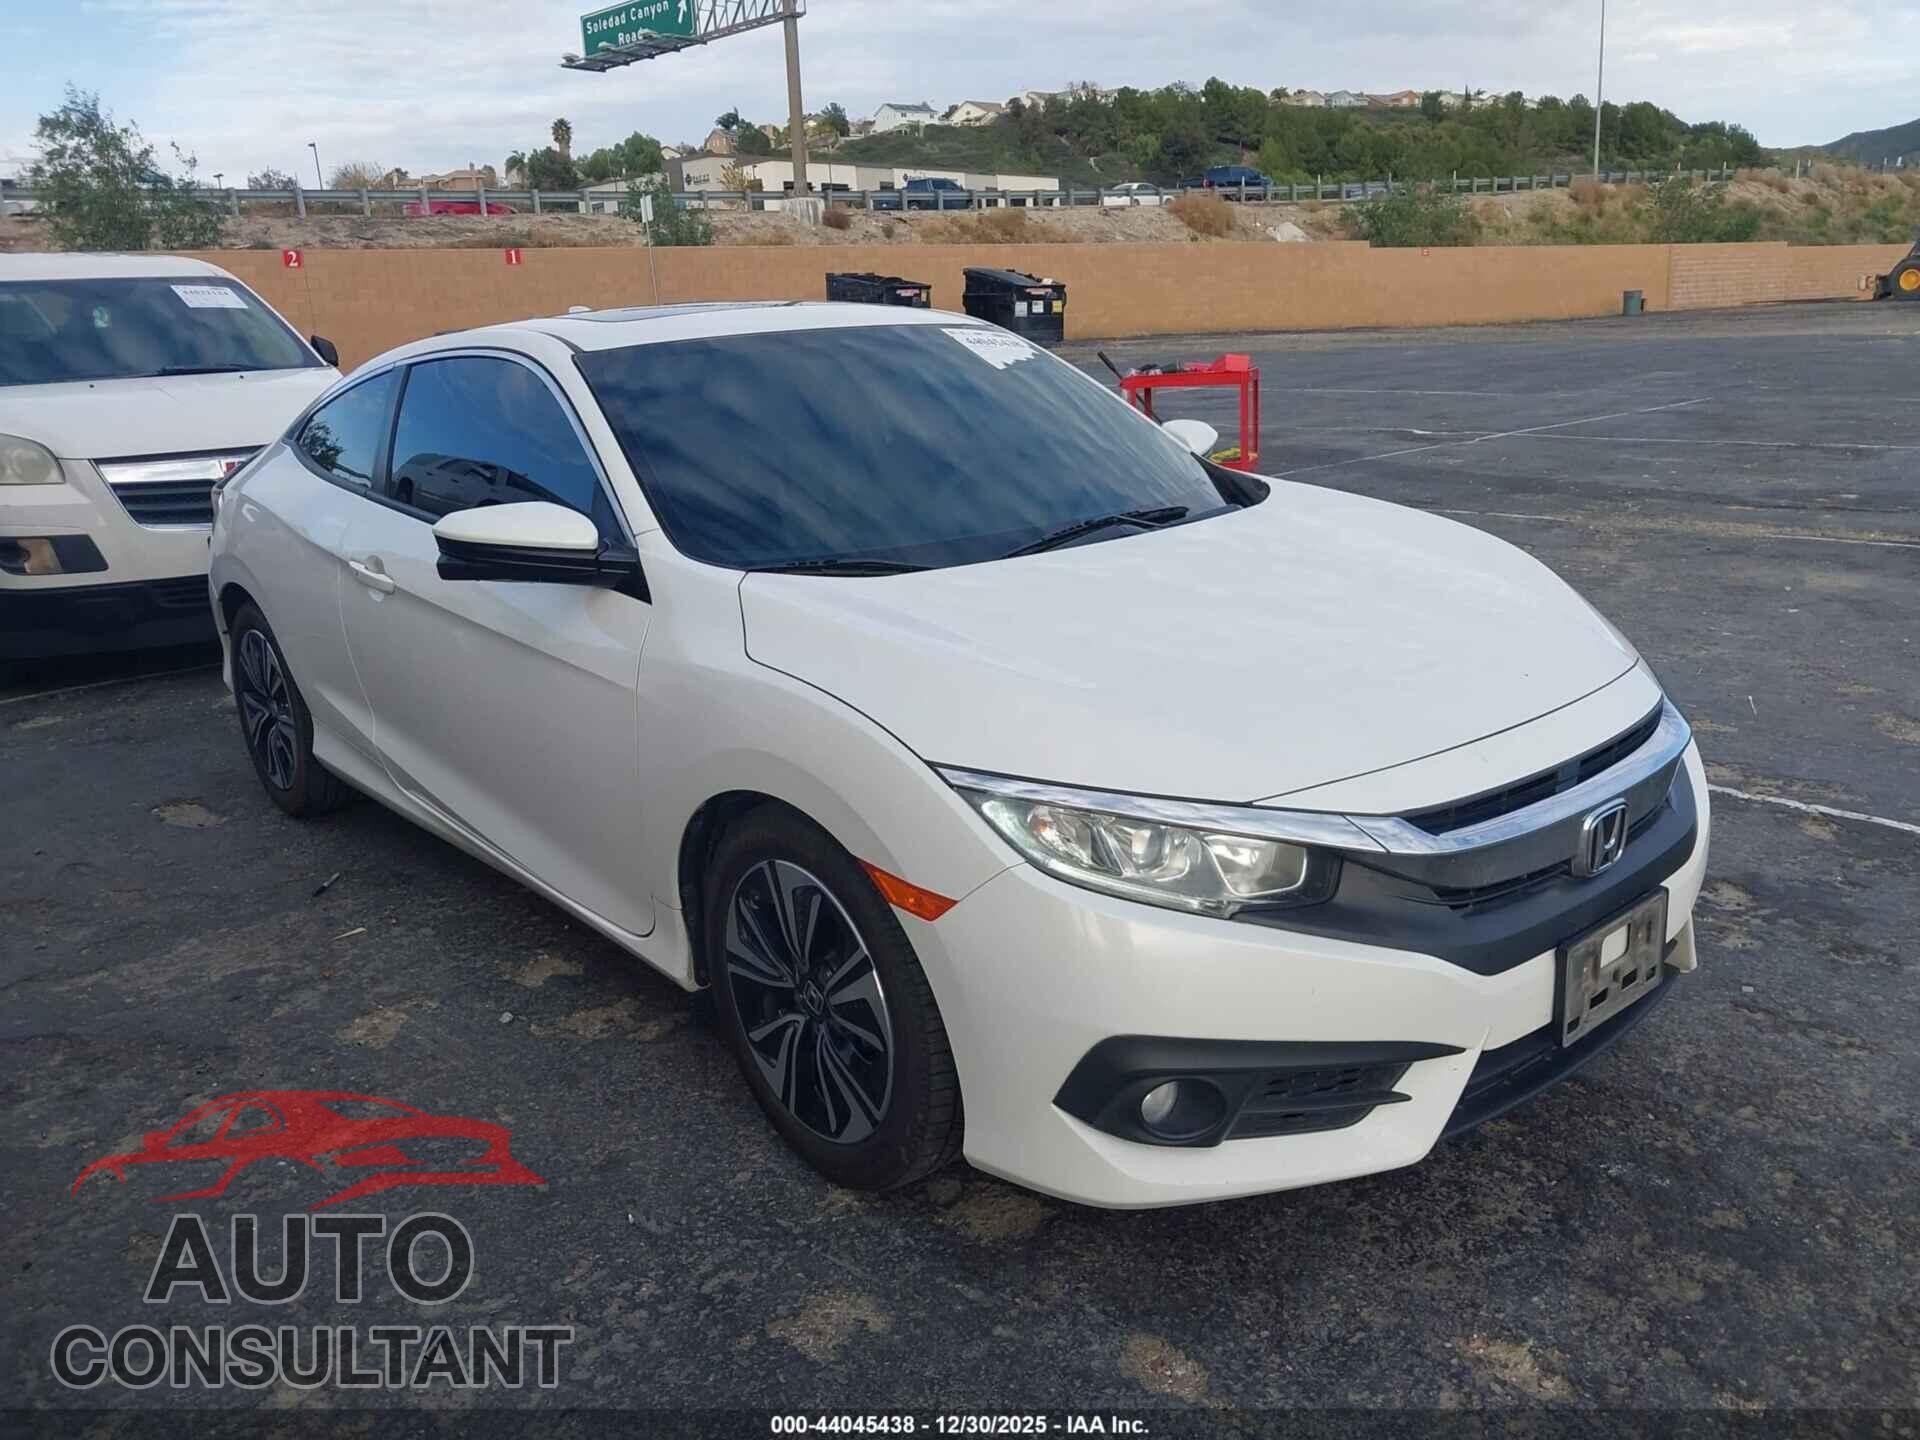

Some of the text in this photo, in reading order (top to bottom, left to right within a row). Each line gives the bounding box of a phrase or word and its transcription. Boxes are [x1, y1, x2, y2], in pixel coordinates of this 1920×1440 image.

[586, 0, 670, 34] Soledad Canyon
[288, 251, 298, 267] 2
